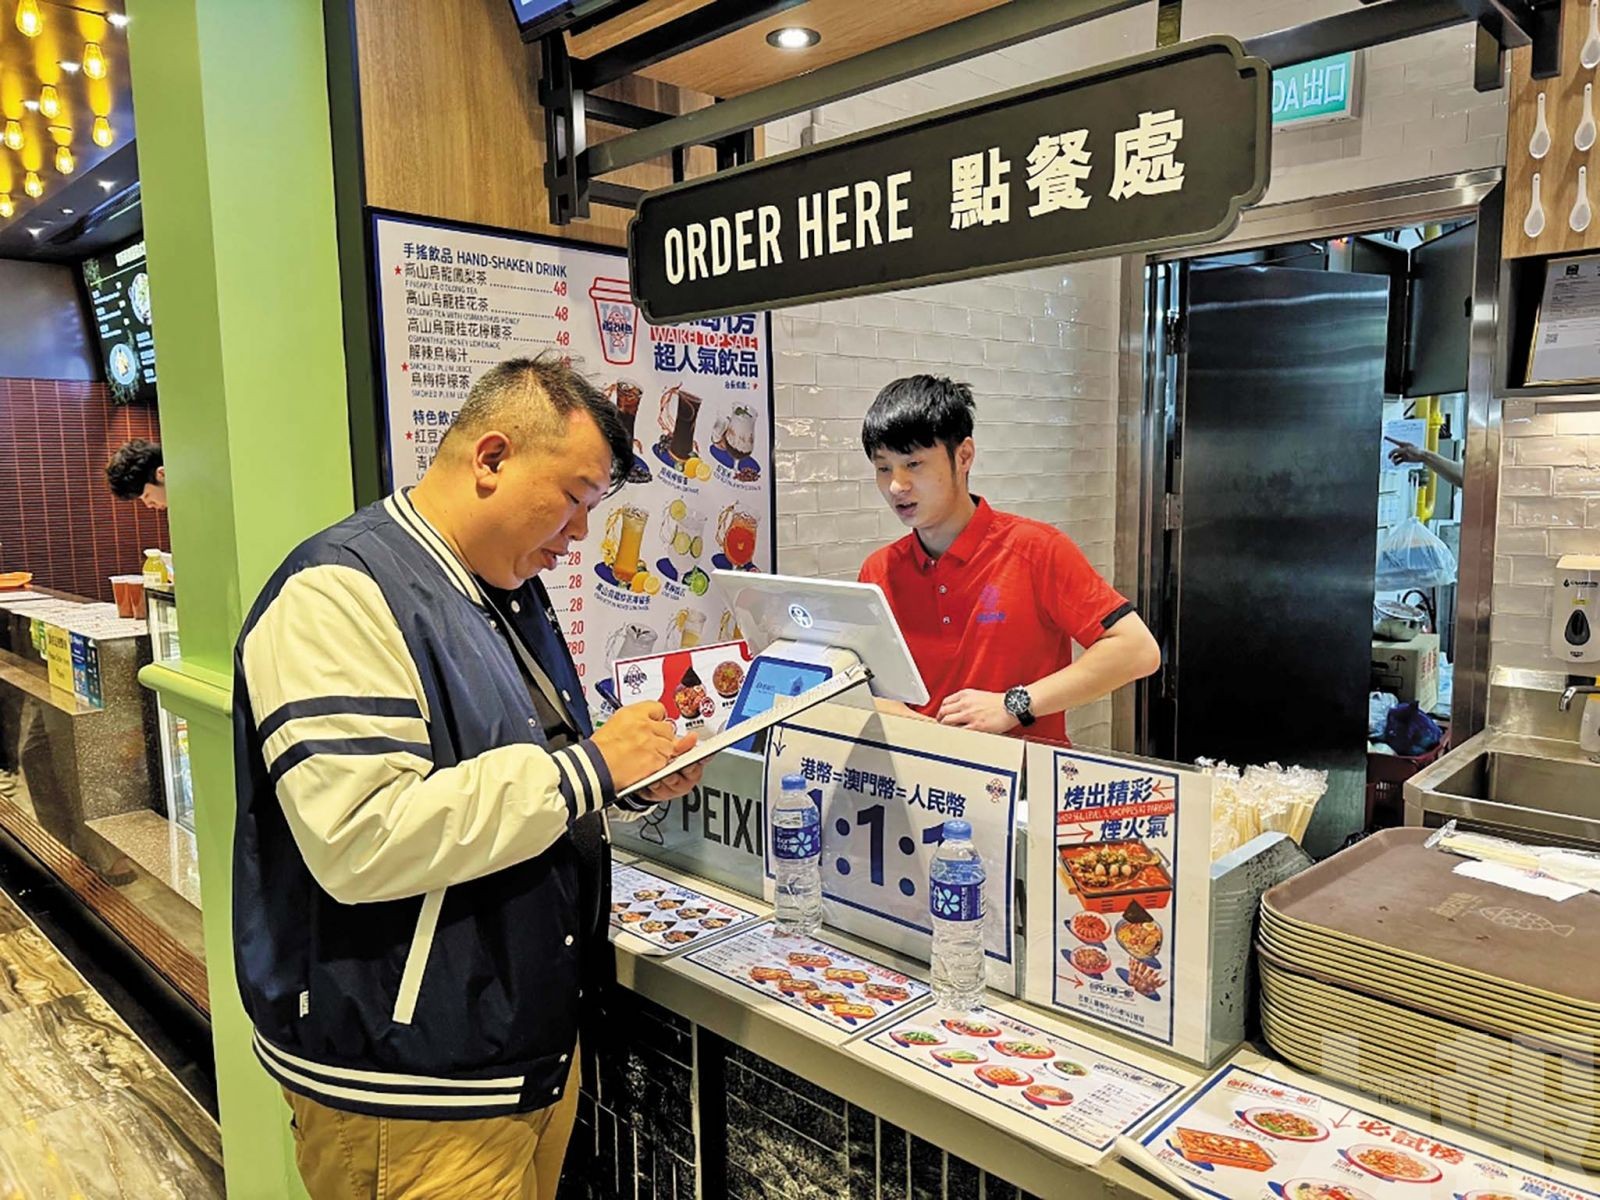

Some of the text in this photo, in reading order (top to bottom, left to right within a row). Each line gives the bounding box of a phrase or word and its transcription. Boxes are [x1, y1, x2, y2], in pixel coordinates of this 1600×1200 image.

[1303, 62, 1346, 108] 出口
[664, 109, 1185, 284] ORDER HERE 點餐處
[403, 243, 567, 278] 手搖飲品 HAND-SHAKEN DRINK
[554, 281, 567, 296] 48
[555, 306, 568, 321] 48
[556, 331, 570, 346] 48
[654, 342, 758, 377] 超人氣飲品
[568, 551, 581, 566] 28
[569, 574, 583, 589] 28
[570, 597, 583, 612] 28
[571, 621, 584, 635] 20
[800, 756, 967, 818] 港幣=澳門幣=人民幣
[1063, 777, 1153, 810] 烤出精彩
[1100, 814, 1168, 841] 煙火氣
[1357, 1118, 1465, 1165] 必試榜
